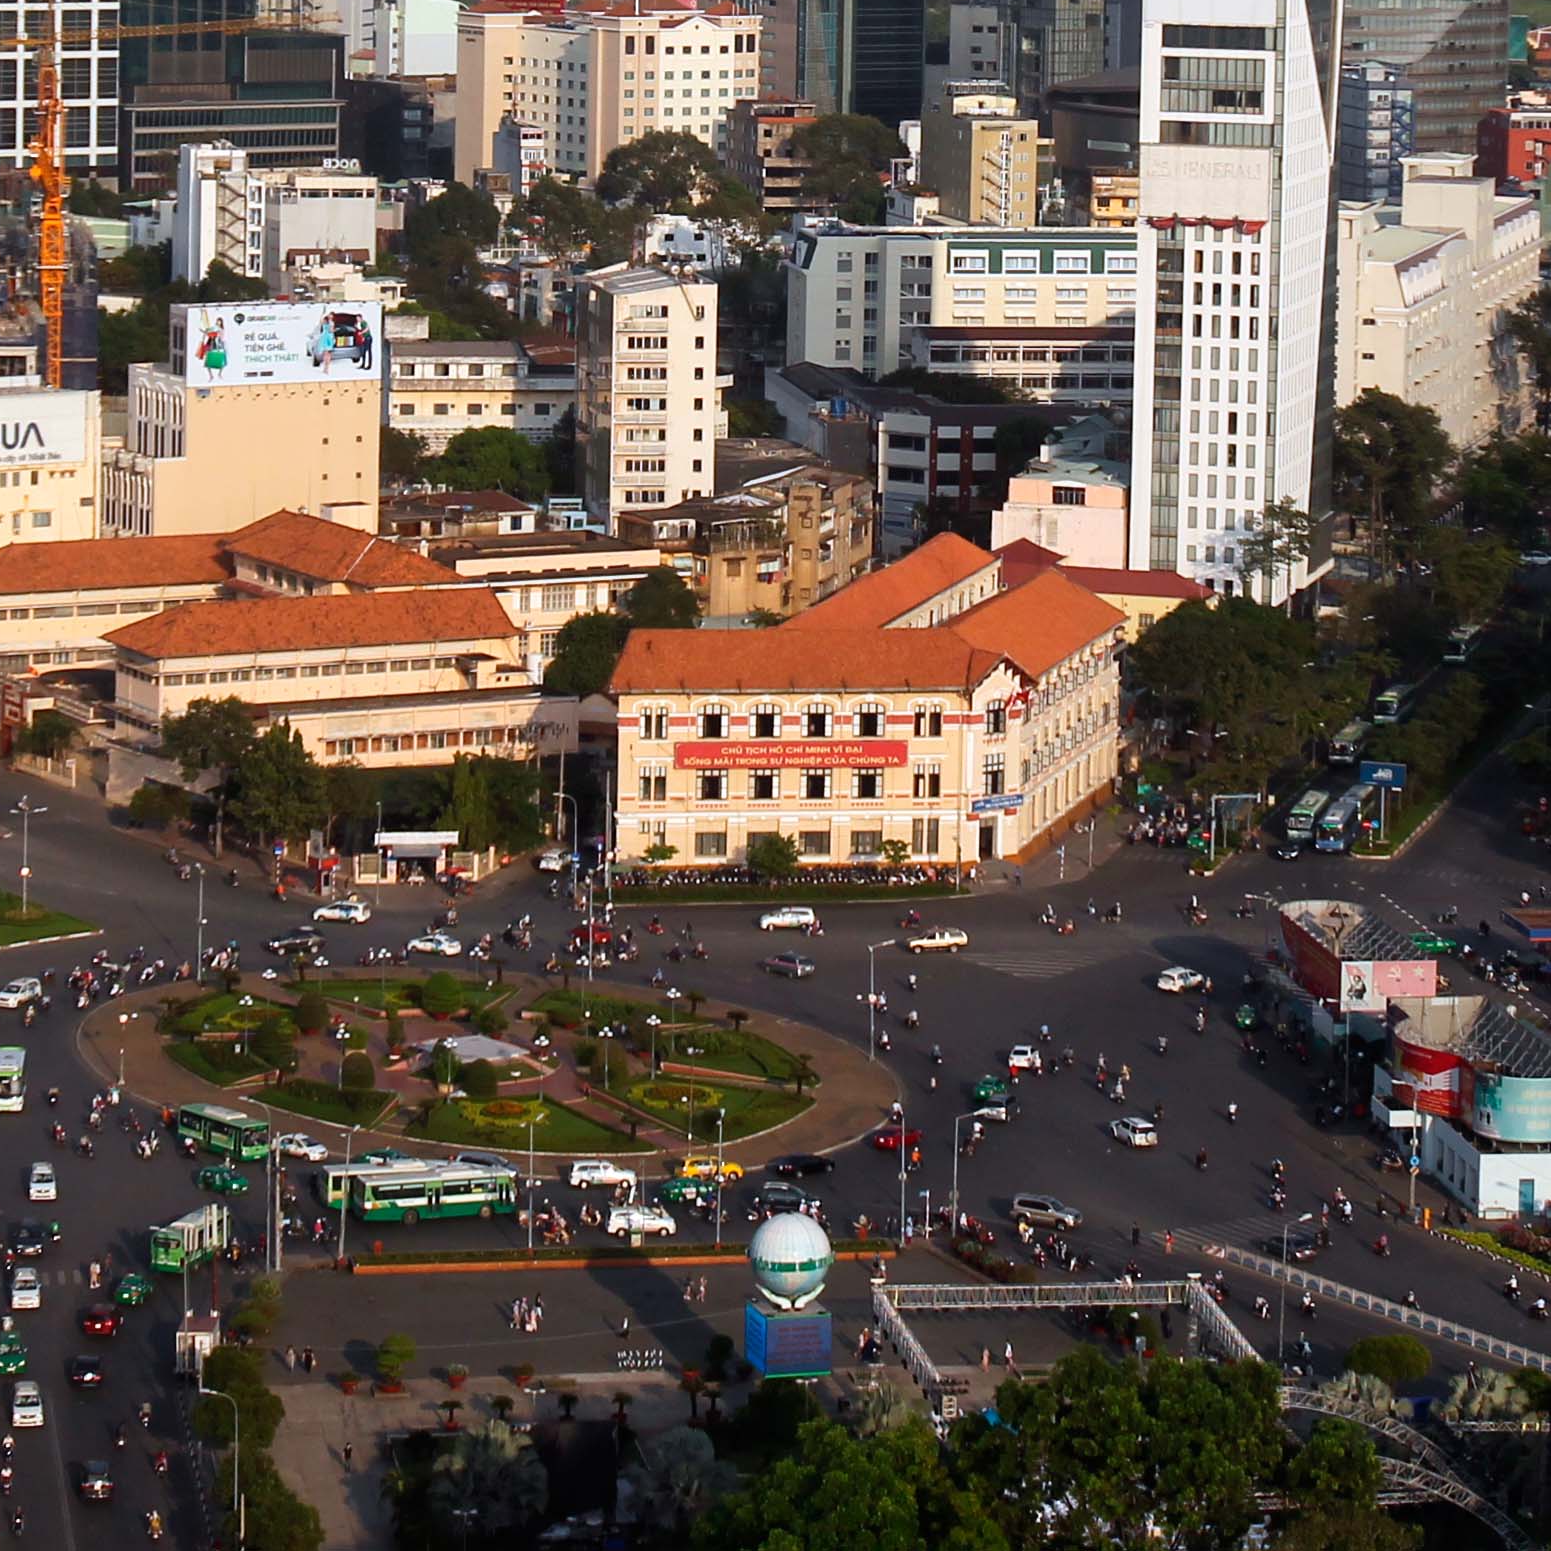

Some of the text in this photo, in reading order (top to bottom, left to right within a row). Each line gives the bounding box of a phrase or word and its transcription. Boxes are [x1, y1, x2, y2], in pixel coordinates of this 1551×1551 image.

[721, 745, 743, 754] CHỦ
[746, 746, 767, 755] TỊCH
[785, 745, 803, 753] CHÍ
[735, 757, 768, 765] TRONG
[785, 756, 823, 766] NGHIỆP
[824, 755, 846, 764] CỦA
[849, 755, 885, 764] CHÚNG
[888, 756, 899, 764] TA
